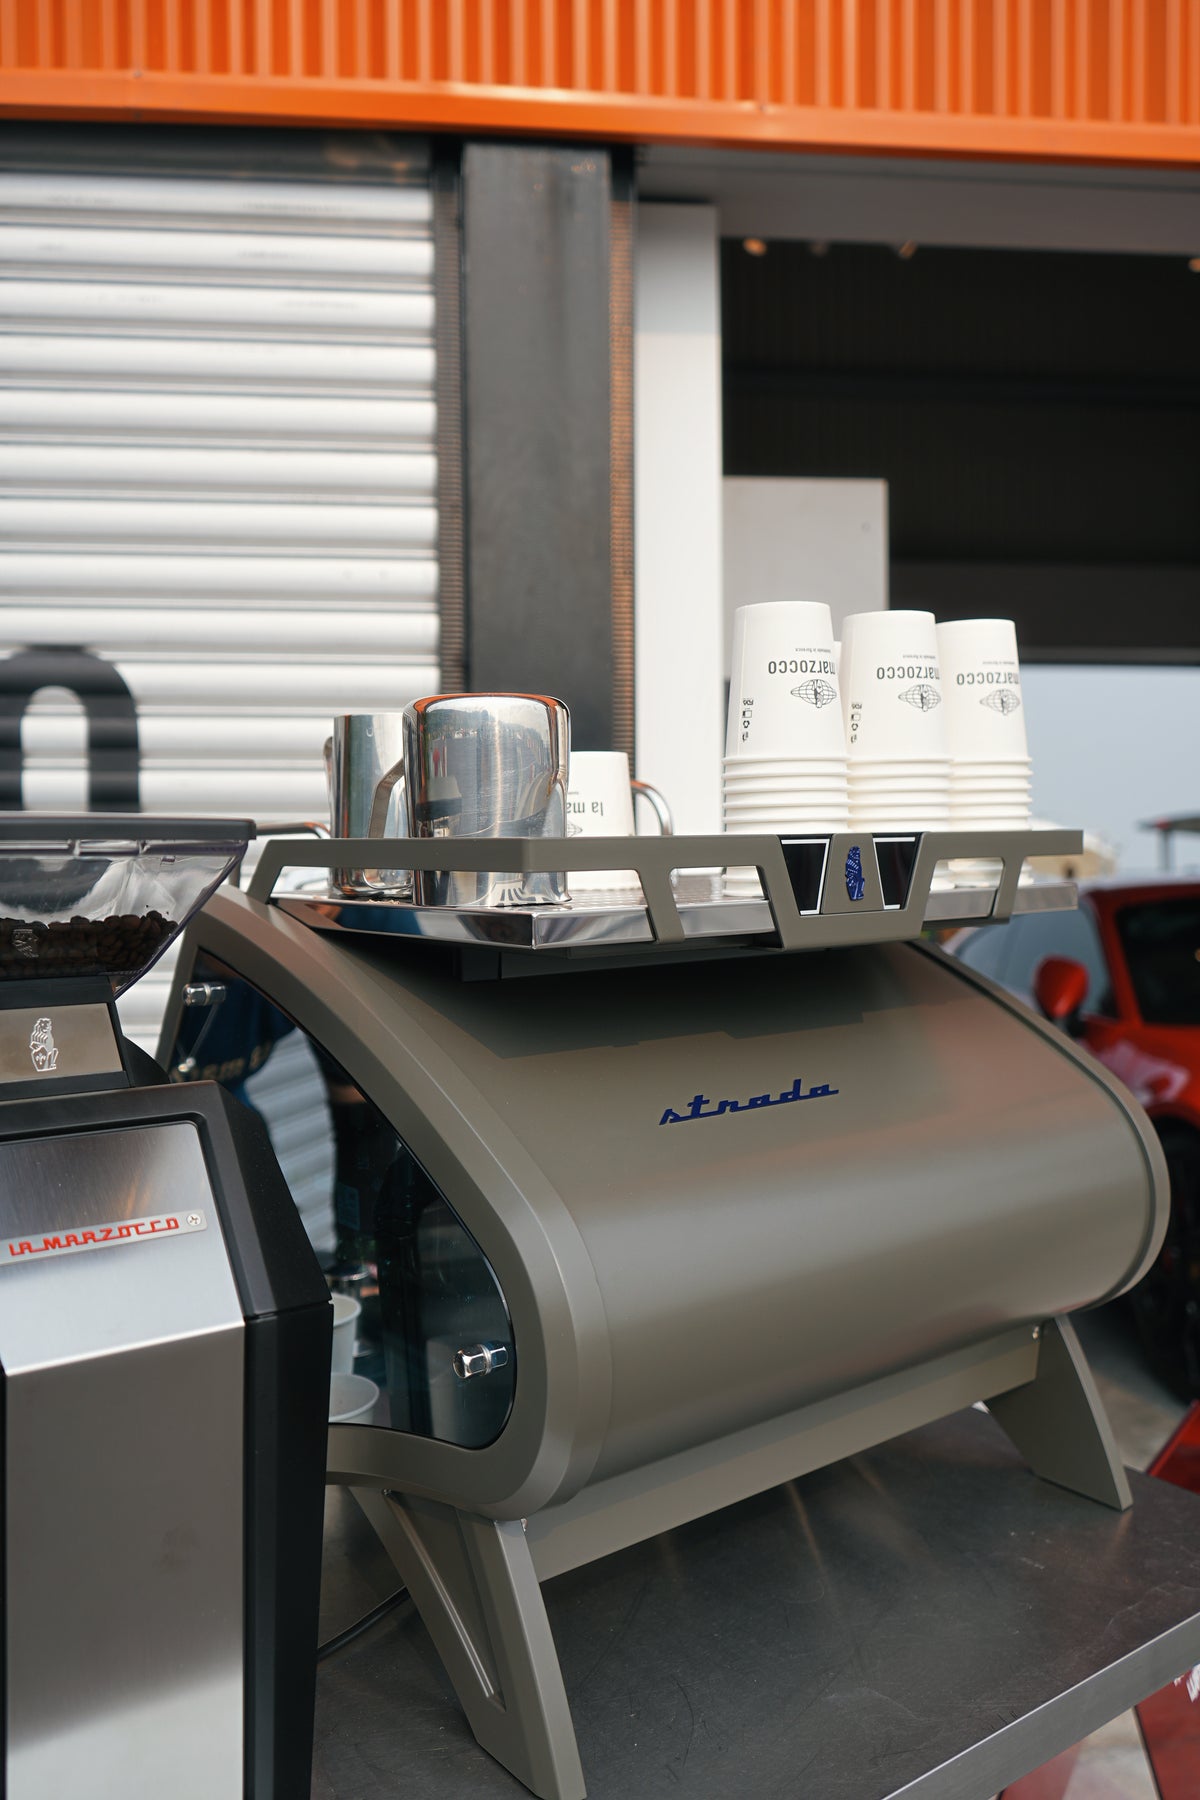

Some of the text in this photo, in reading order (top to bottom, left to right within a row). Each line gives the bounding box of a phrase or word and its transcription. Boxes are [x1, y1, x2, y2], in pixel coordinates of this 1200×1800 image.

[591, 801, 604, 816] la
[659, 1078, 840, 1126] strada
[8, 1216, 180, 1257] LA MARZOCCO
